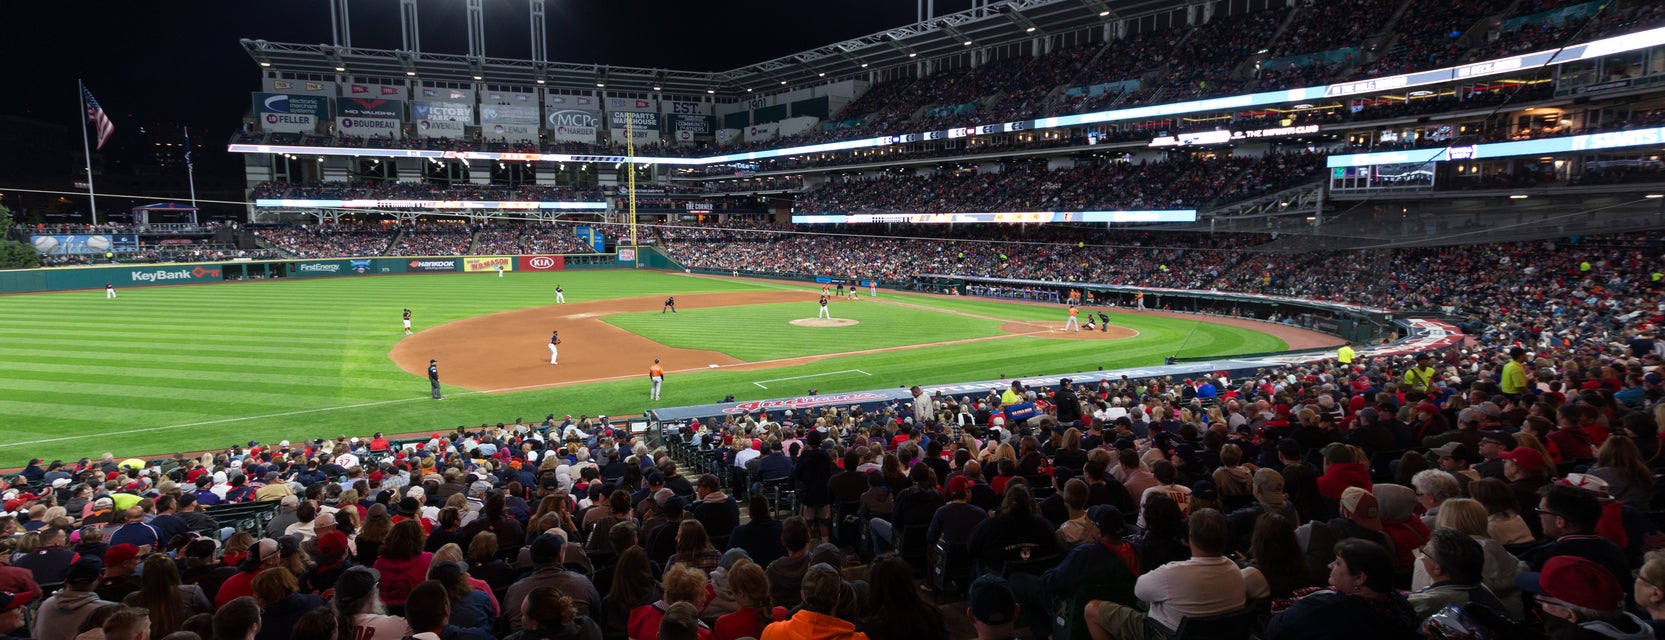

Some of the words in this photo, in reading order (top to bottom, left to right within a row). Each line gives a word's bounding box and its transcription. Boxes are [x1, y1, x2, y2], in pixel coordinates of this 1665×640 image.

[673, 102, 701, 114] EST.
[279, 116, 309, 124] FELLER
[354, 120, 395, 128] BOUDREAU
[505, 126, 528, 134] LEMON
[1590, 129, 1658, 148] STARTS
[300, 264, 340, 272] FirstEnergy
[132, 270, 191, 282] KeyBank
[722, 392, 888, 413] Indians
